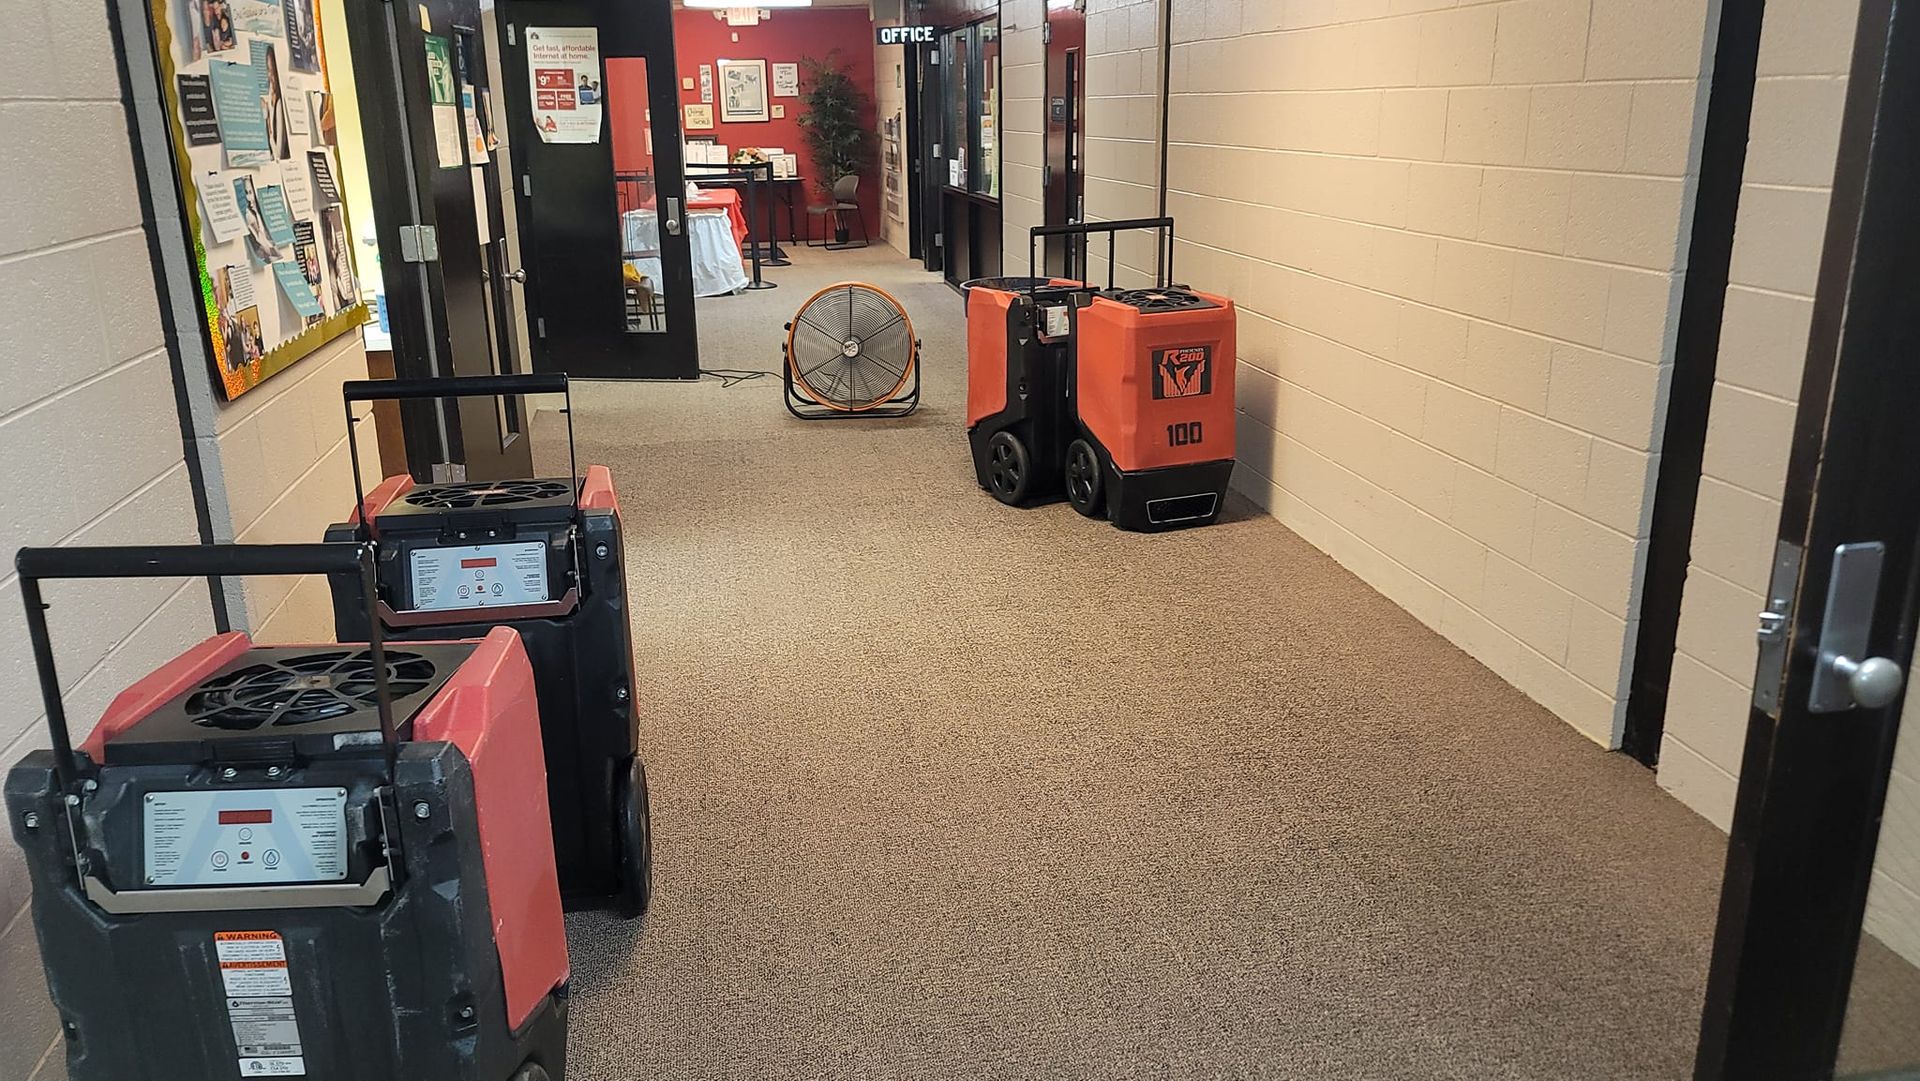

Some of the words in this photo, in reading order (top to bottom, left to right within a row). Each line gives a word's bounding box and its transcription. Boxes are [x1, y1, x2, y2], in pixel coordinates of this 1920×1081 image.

[881, 26, 934, 44] OFFICE
[562, 44, 595, 52] affordable
[533, 52, 559, 60] Internet
[569, 52, 589, 60] home.
[1167, 421, 1202, 447] 100
[226, 932, 277, 941] WARNING
[229, 960, 285, 969] AVERTISSEMENT
